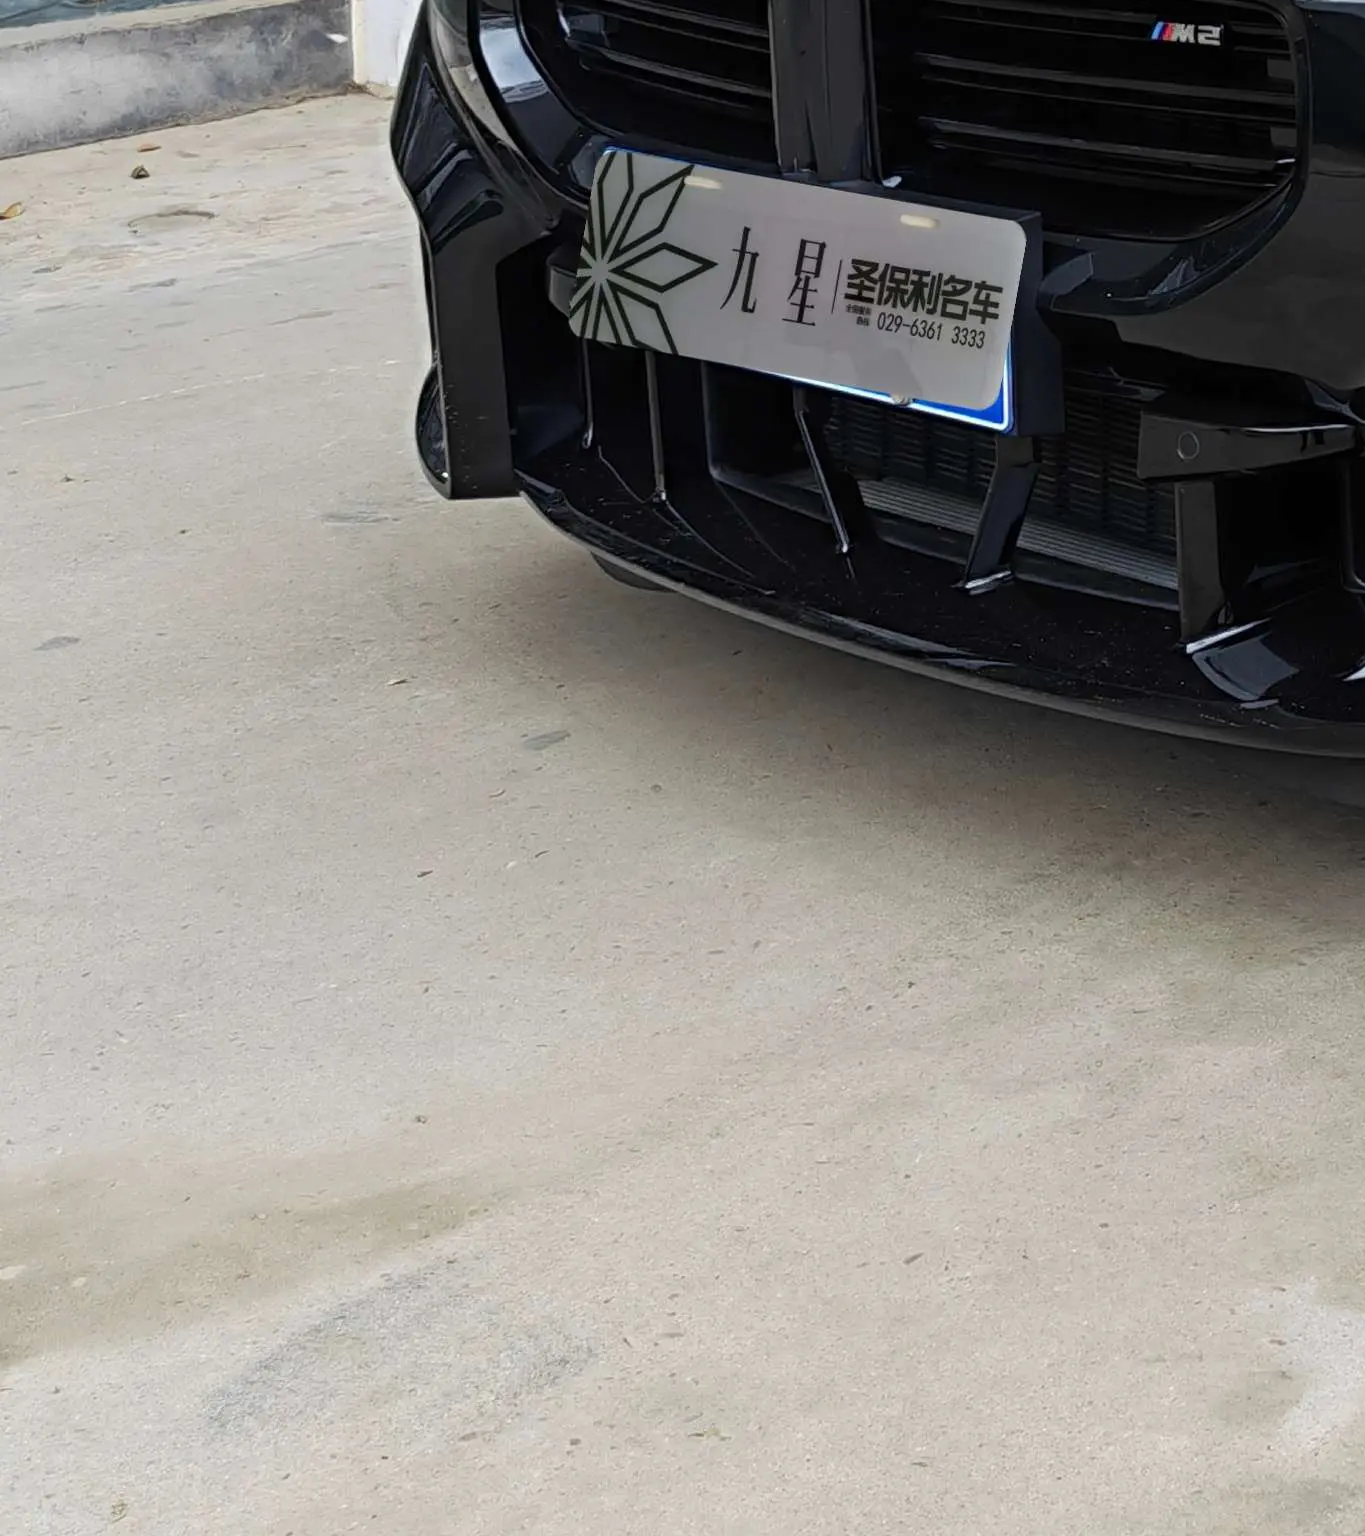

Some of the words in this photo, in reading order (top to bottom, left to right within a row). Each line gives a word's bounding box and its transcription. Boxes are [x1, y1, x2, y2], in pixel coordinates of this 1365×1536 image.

[1170, 22, 1224, 46] M2
[720, 226, 827, 327] 九星
[844, 258, 1003, 325] 圣保利名车
[876, 311, 943, 342] 029-6361
[951, 325, 987, 350] 3333
